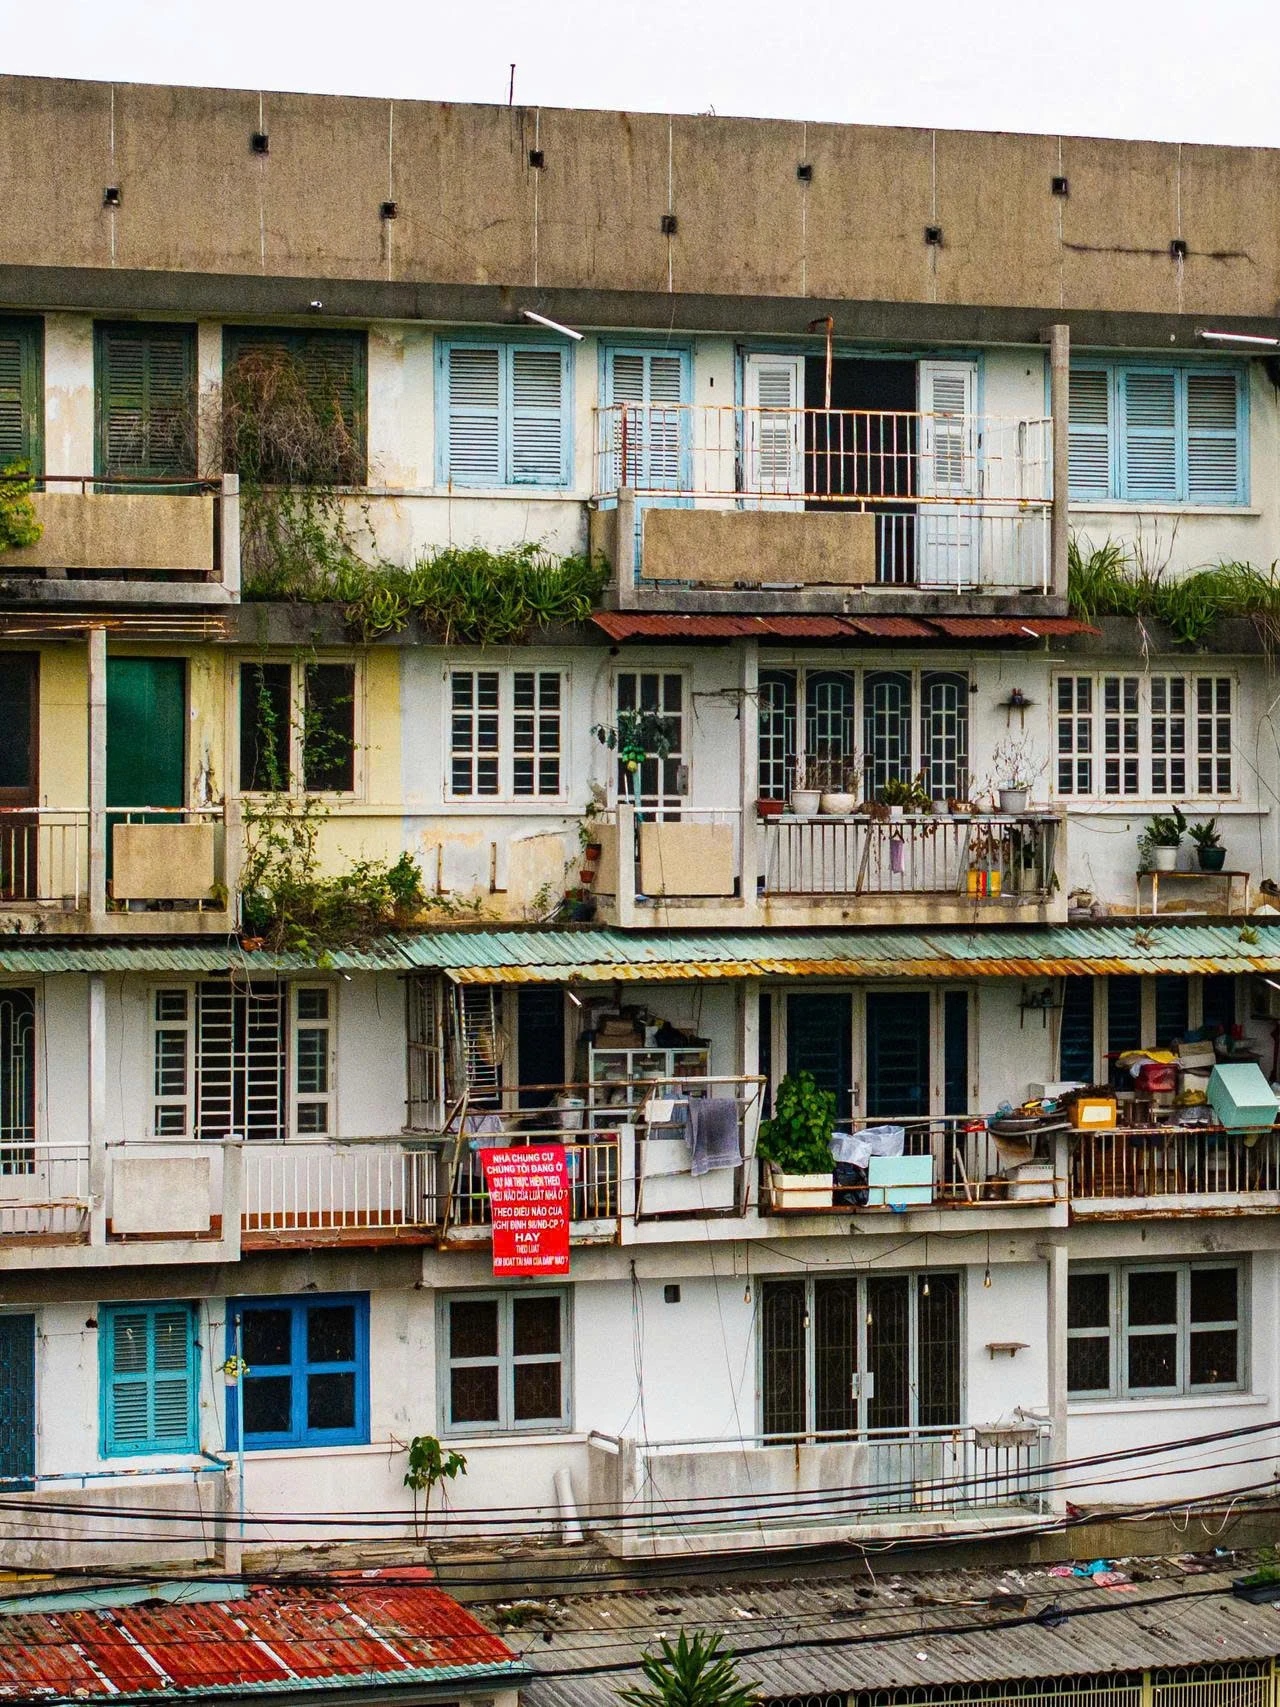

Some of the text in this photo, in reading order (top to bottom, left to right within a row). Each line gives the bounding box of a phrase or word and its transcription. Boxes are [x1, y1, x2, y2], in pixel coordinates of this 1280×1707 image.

[493, 1152, 555, 1163] NHÀ CHUNG CƯ
[486, 1162, 515, 1174] CHÚNG
[516, 1162, 530, 1173] TÔI
[531, 1163, 554, 1172] ĐANG
[544, 1176, 560, 1186] THEO
[503, 1188, 516, 1200] NÀO
[516, 1187, 528, 1200] CỦA
[529, 1187, 544, 1200] LUẬT
[545, 1187, 557, 1200] NHÀ
[494, 1206, 512, 1216] THEO
[531, 1203, 547, 1216] NÀO
[515, 1232, 541, 1242] HAY
